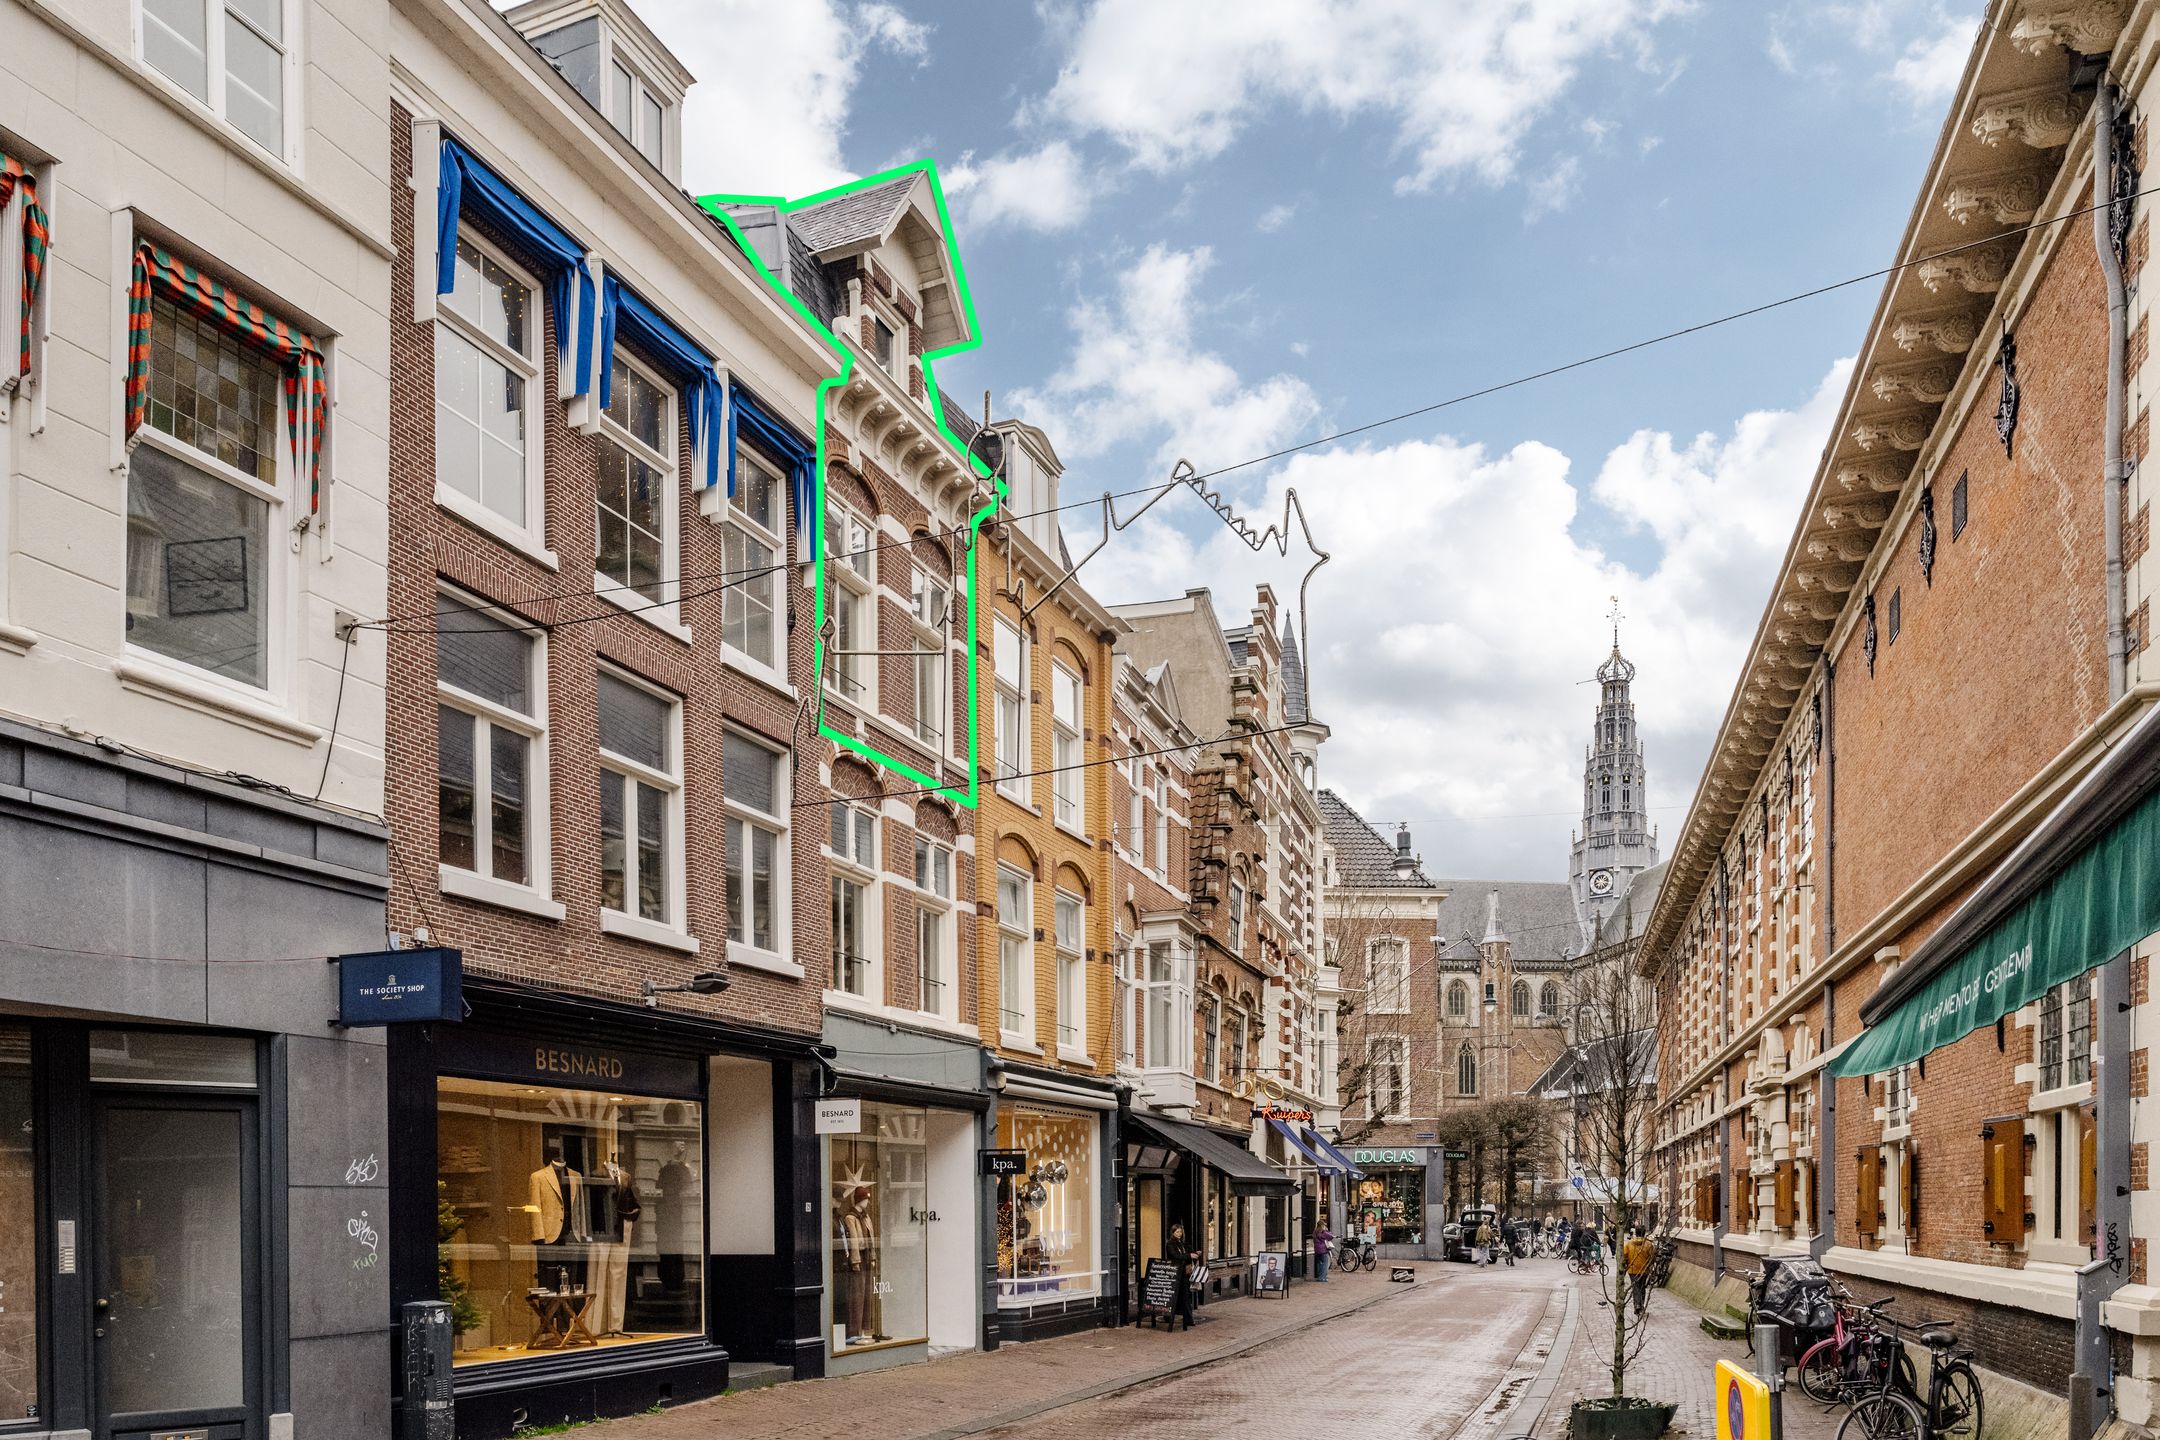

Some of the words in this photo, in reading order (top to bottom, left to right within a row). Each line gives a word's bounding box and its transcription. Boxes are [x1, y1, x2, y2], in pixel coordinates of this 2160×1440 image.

[360, 988, 374, 996] THE
[376, 985, 406, 995] SOCIETY
[407, 984, 425, 993] SHOP
[535, 1047, 623, 1079] BESNARD
[821, 1110, 855, 1118] BESNARD
[1261, 1100, 1312, 1122] Kuipers
[992, 1157, 1017, 1173] kpa.
[1354, 1150, 1416, 1163] DOUGLAS
[910, 1207, 941, 1225] kpa.
[873, 1276, 894, 1299] kpa.
